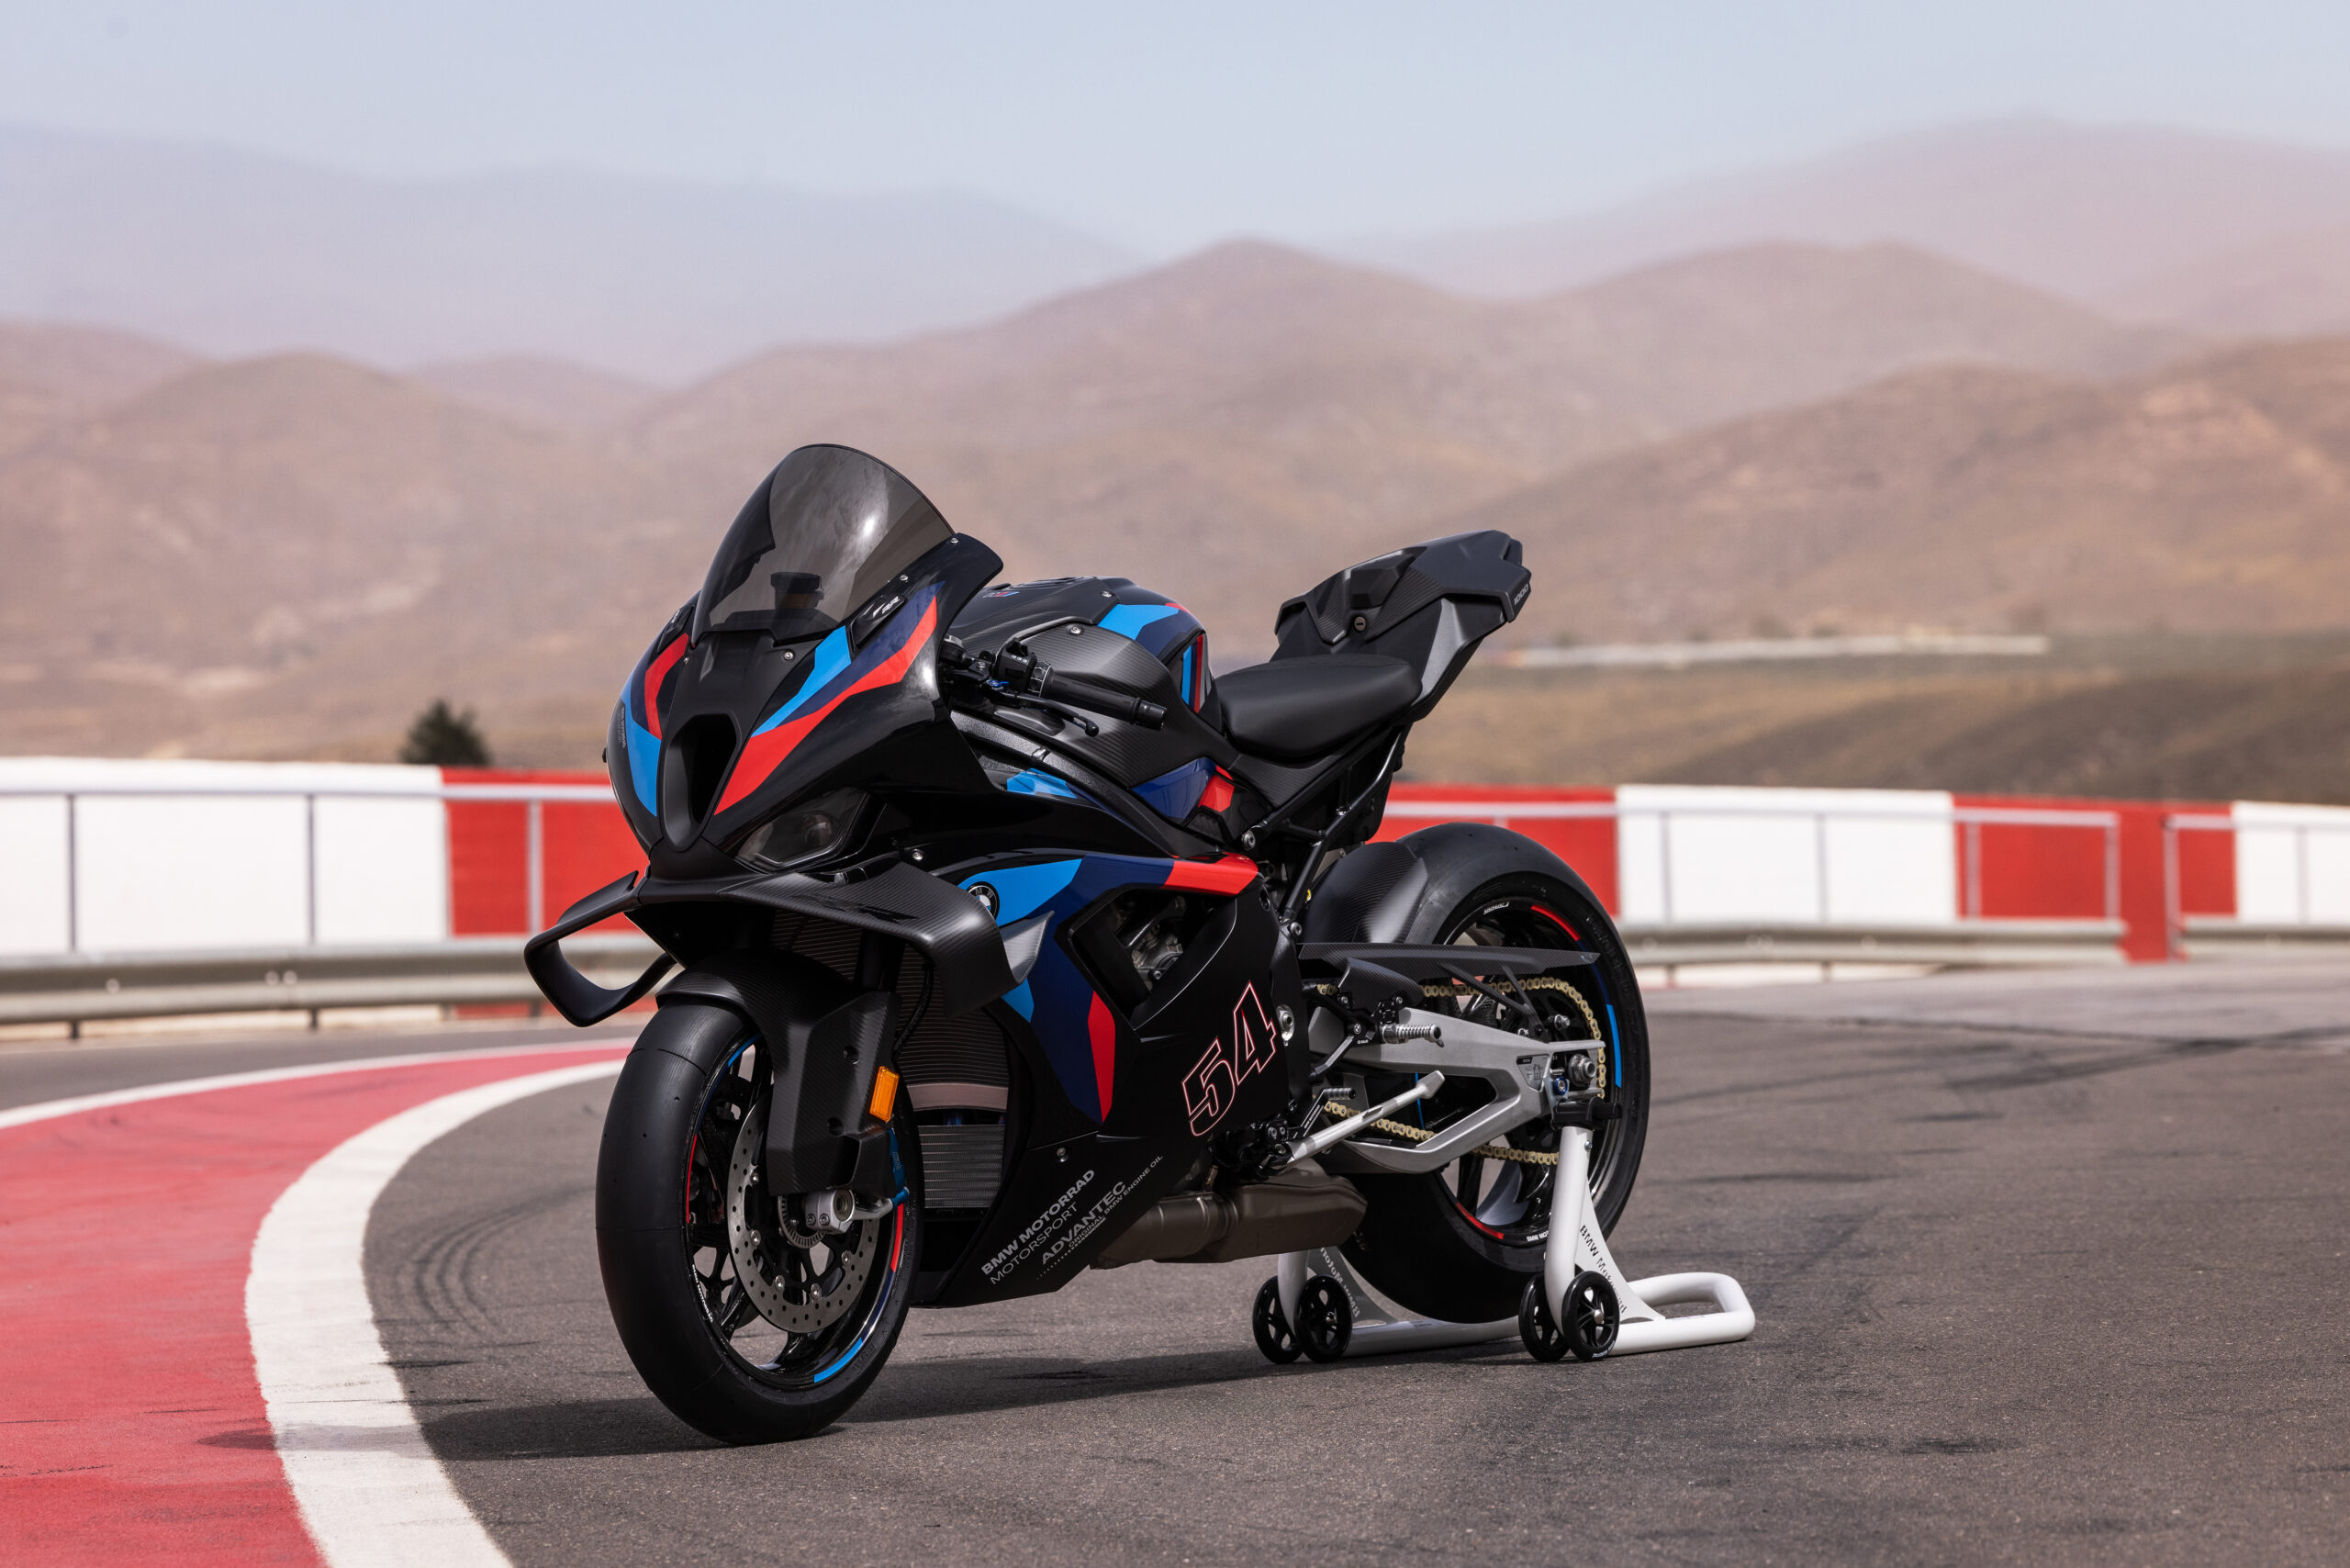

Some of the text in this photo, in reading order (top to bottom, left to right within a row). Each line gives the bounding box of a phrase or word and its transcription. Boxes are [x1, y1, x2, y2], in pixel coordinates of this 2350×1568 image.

[1514, 583, 1528, 606] 1000
[1181, 979, 1277, 1137] 54
[981, 1170, 1095, 1276] BMW MOTORRAD
[990, 1202, 1079, 1285] MOTORSPORT
[1042, 1181, 1127, 1265] ADVANTEC
[1069, 1155, 1164, 1248] ORIGINAL BMW ENGINE OIL
[1579, 1225, 1599, 1257] BMW
